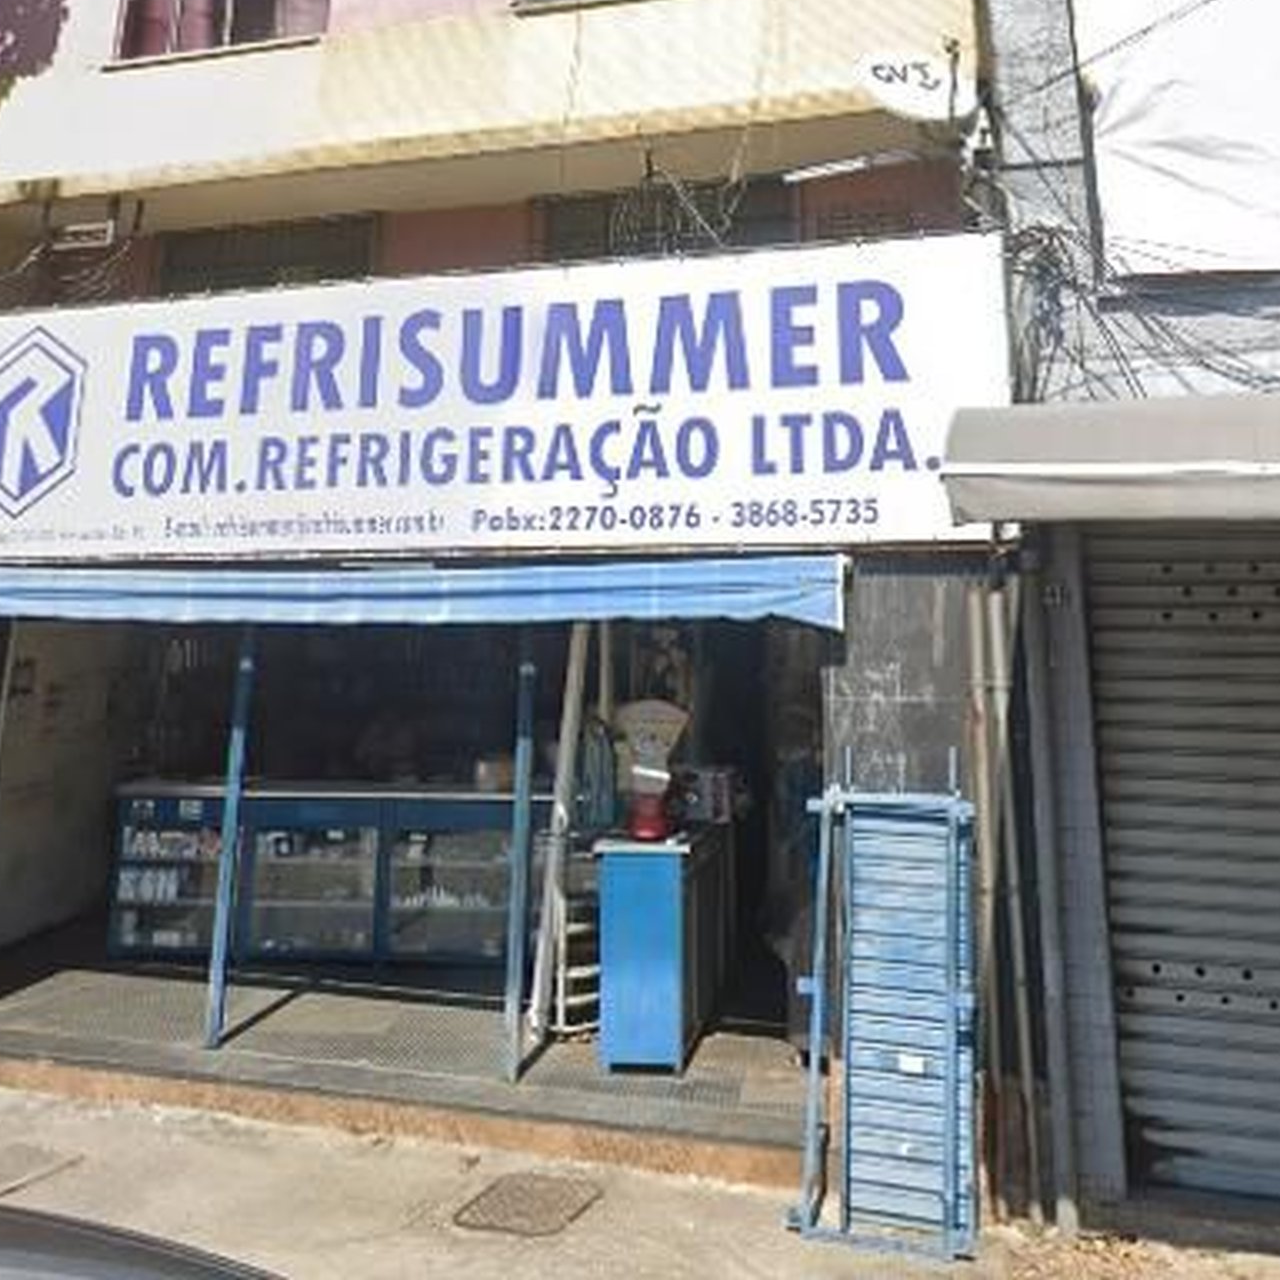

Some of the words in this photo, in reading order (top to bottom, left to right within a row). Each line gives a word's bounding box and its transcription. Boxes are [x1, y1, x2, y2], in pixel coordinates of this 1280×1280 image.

[125, 279, 911, 422] REFRISUMMER
[751, 408, 941, 475] LTDA.
[729, 497, 880, 529] 3868-5735
